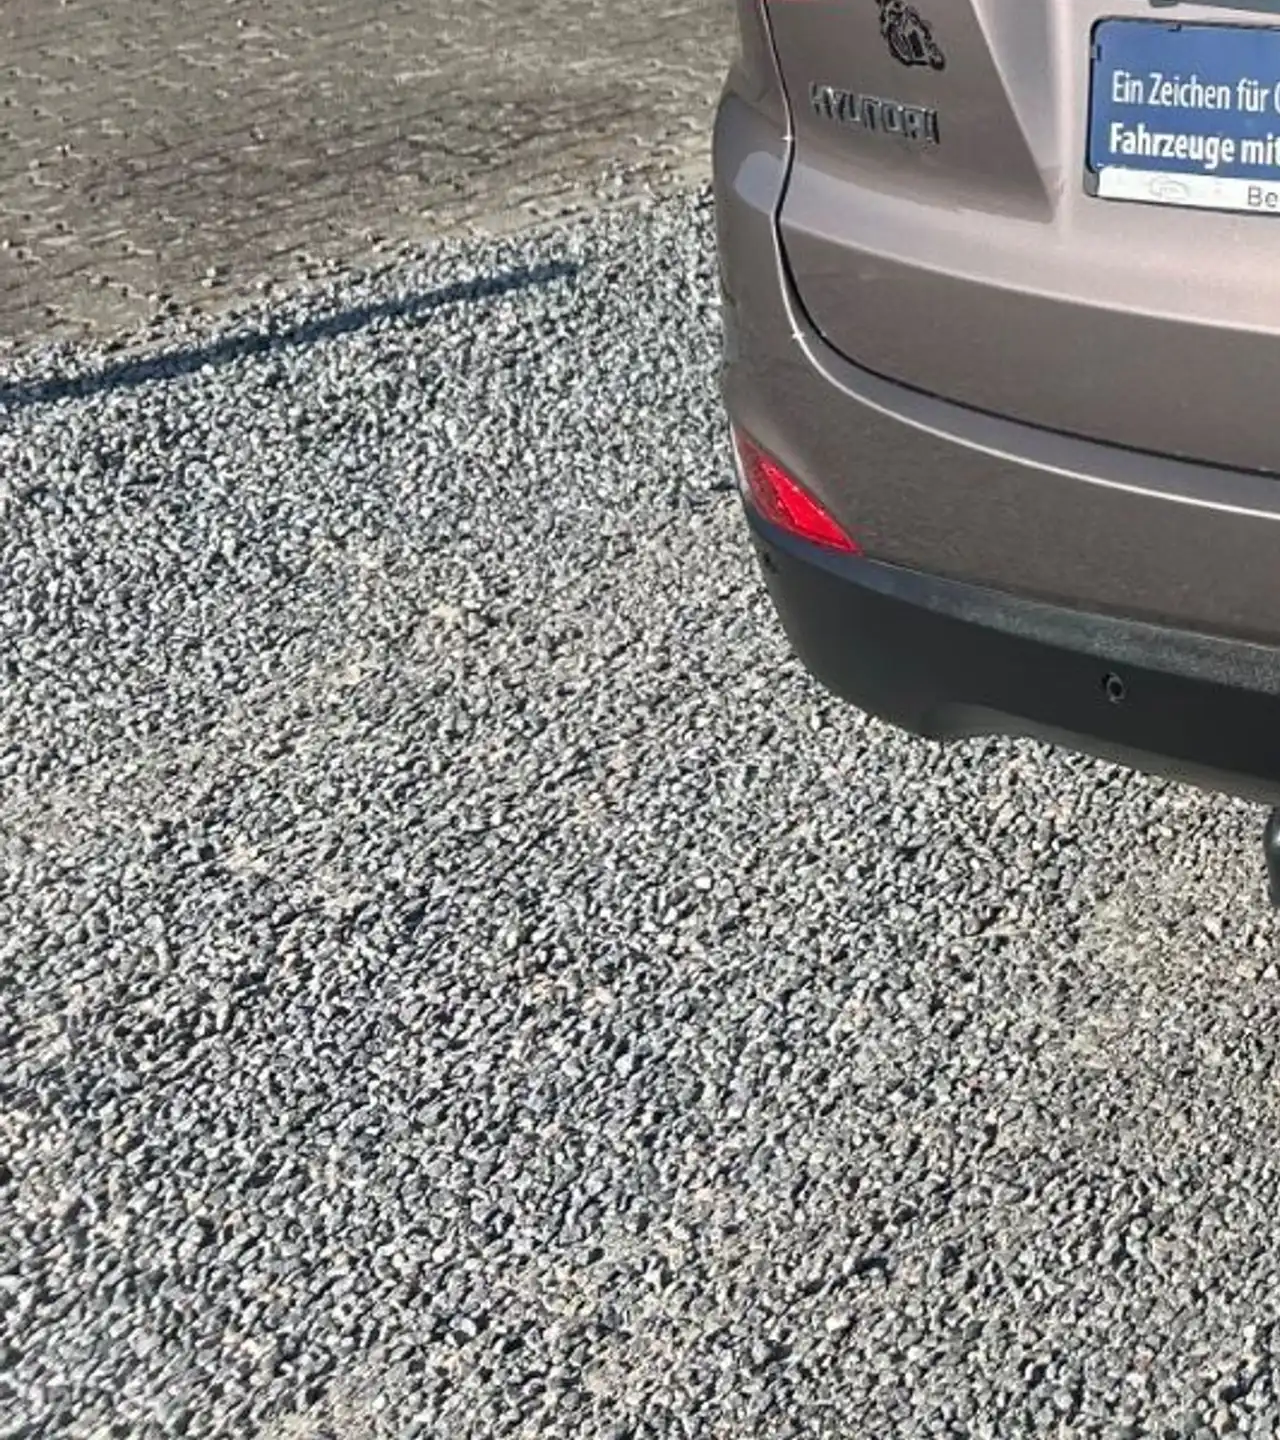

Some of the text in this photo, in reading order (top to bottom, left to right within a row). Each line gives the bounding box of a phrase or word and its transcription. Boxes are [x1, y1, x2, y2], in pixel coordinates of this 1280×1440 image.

[1112, 69, 1143, 104] Ein
[1148, 72, 1231, 110] Zeichen
[1236, 77, 1270, 113] für
[1110, 121, 1236, 170] Fahrzeuge
